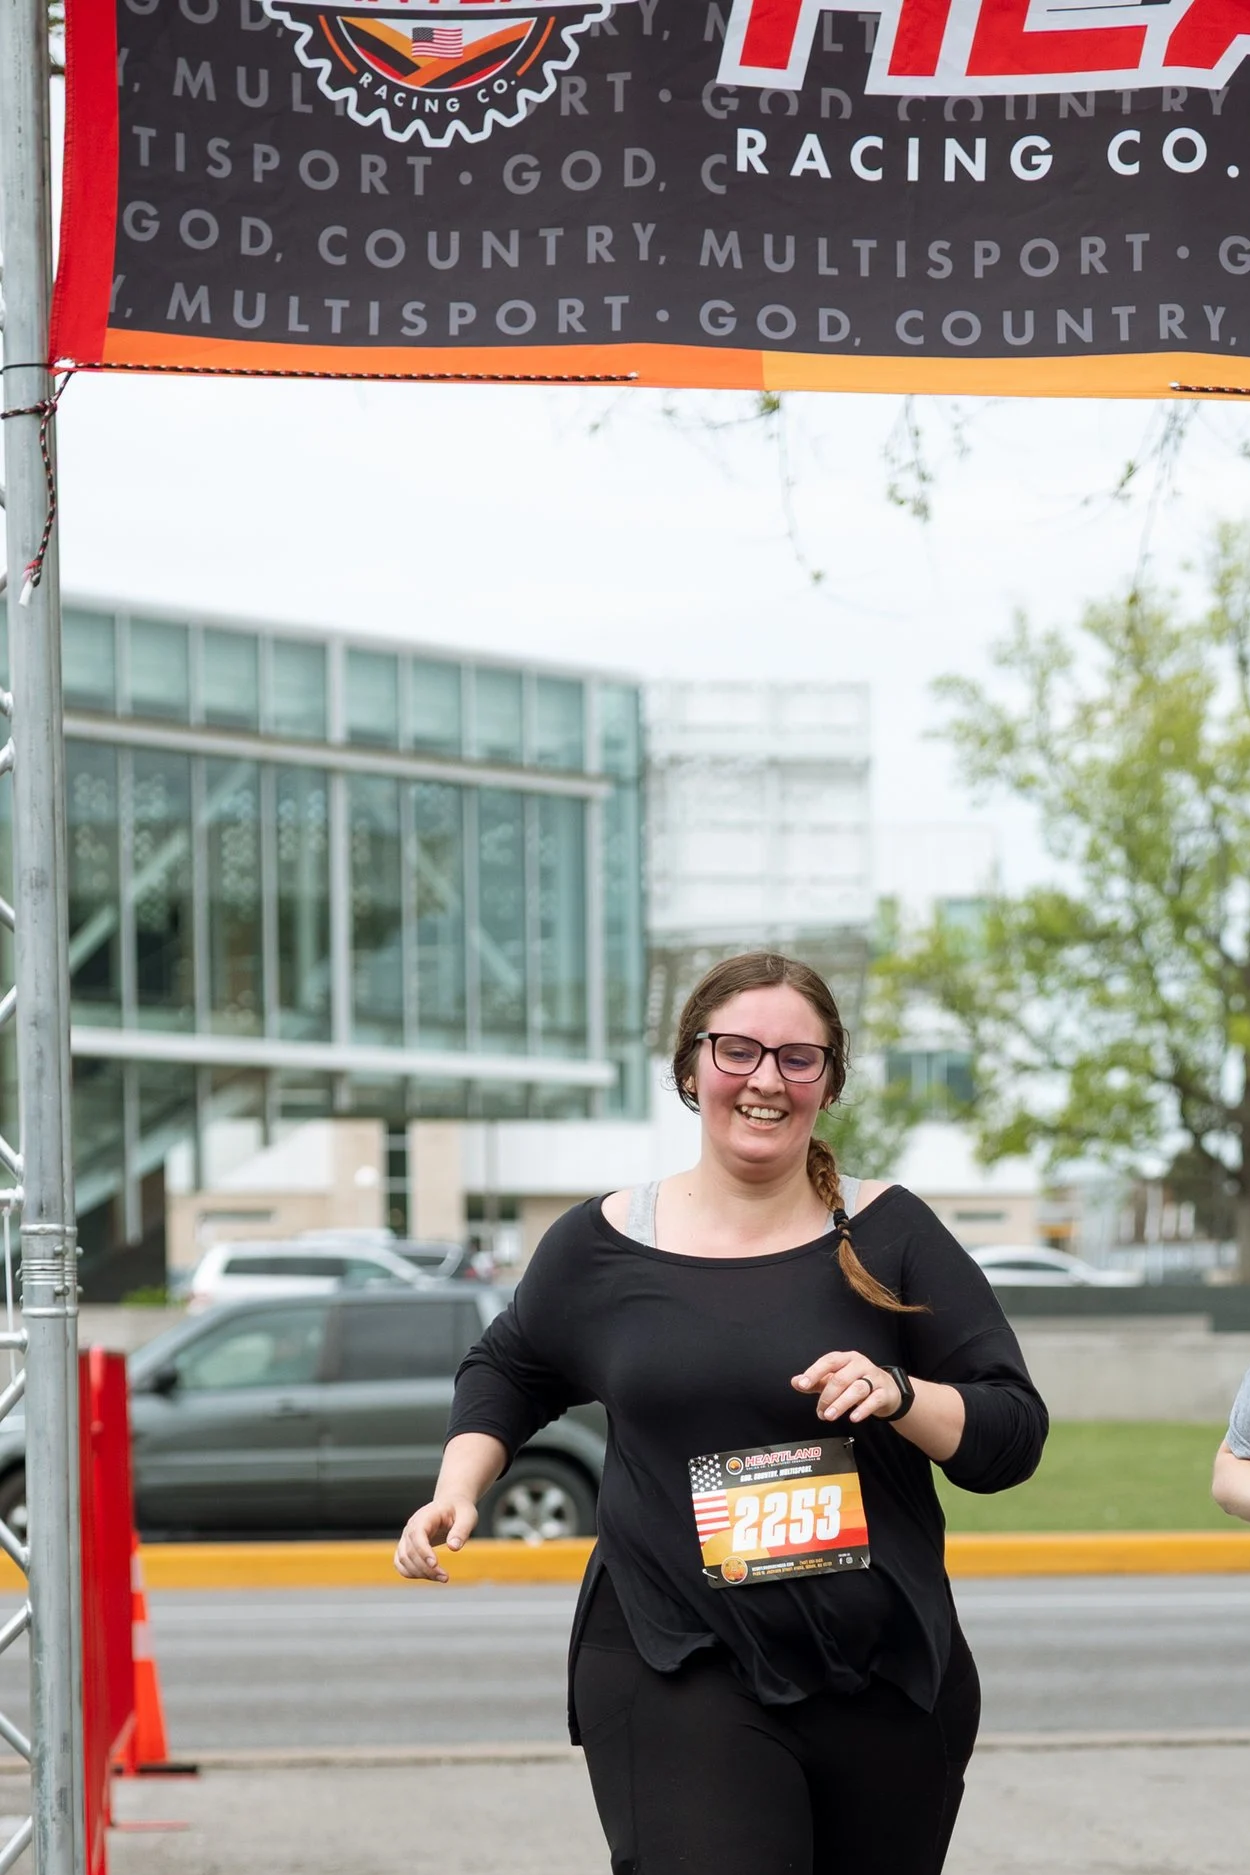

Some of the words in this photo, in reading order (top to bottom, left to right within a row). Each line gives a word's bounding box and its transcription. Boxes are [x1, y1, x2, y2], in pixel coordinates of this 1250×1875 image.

[358, 72, 460, 113] RACING
[477, 78, 517, 104] CO.
[132, 125, 433, 196] TISPORT
[503, 148, 667, 195] GOD,
[736, 127, 1054, 182] RACING
[1107, 127, 1240, 178] CO.
[123, 201, 283, 263] GOD,
[318, 222, 666, 270] COUNTRY,
[700, 229, 1151, 279] MULTISPORT
[166, 282, 631, 337] MULTISPORT
[699, 300, 861, 347] GOD,
[895, 304, 1237, 347] COUNTRY,
[745, 1446, 822, 1468] HEARTLAND
[732, 1485, 842, 1553] 2253
